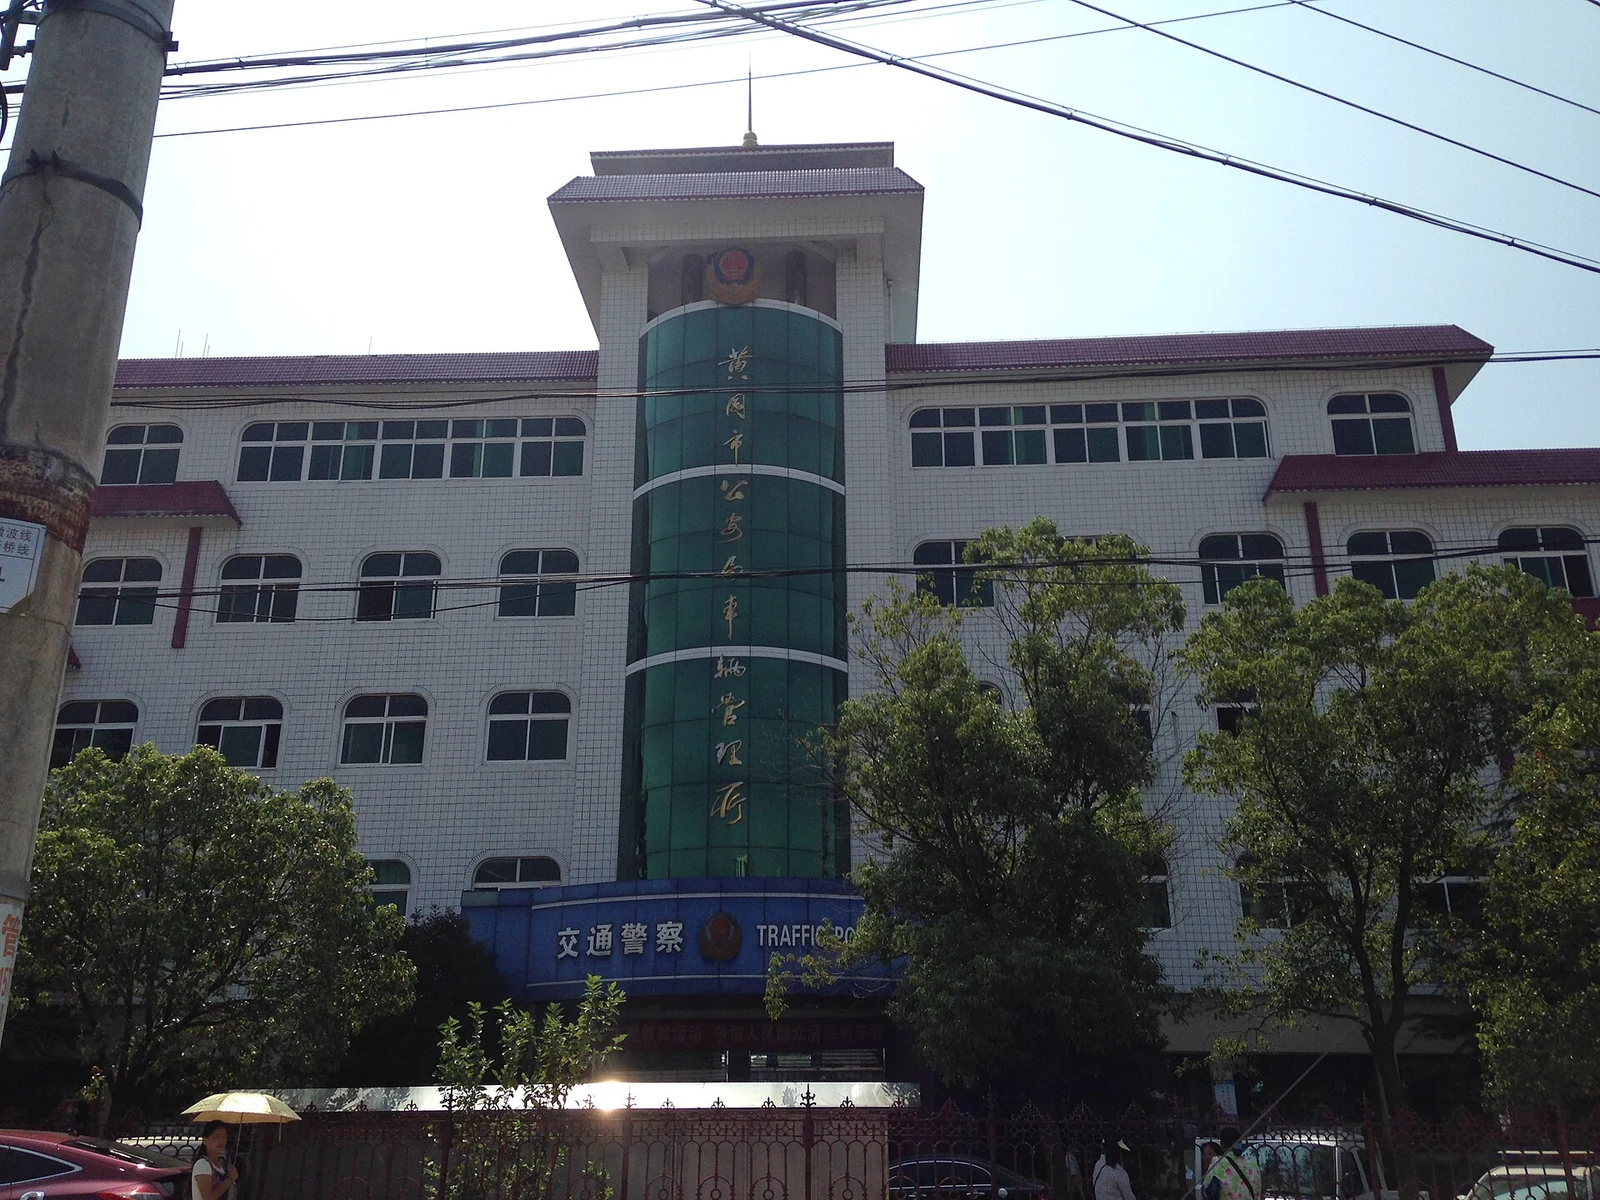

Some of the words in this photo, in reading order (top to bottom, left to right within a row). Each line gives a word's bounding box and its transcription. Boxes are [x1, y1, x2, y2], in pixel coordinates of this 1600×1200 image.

[0, 540, 30, 556] 桥线
[557, 921, 684, 959] 交通警察
[756, 924, 827, 948] TRAFFIC
